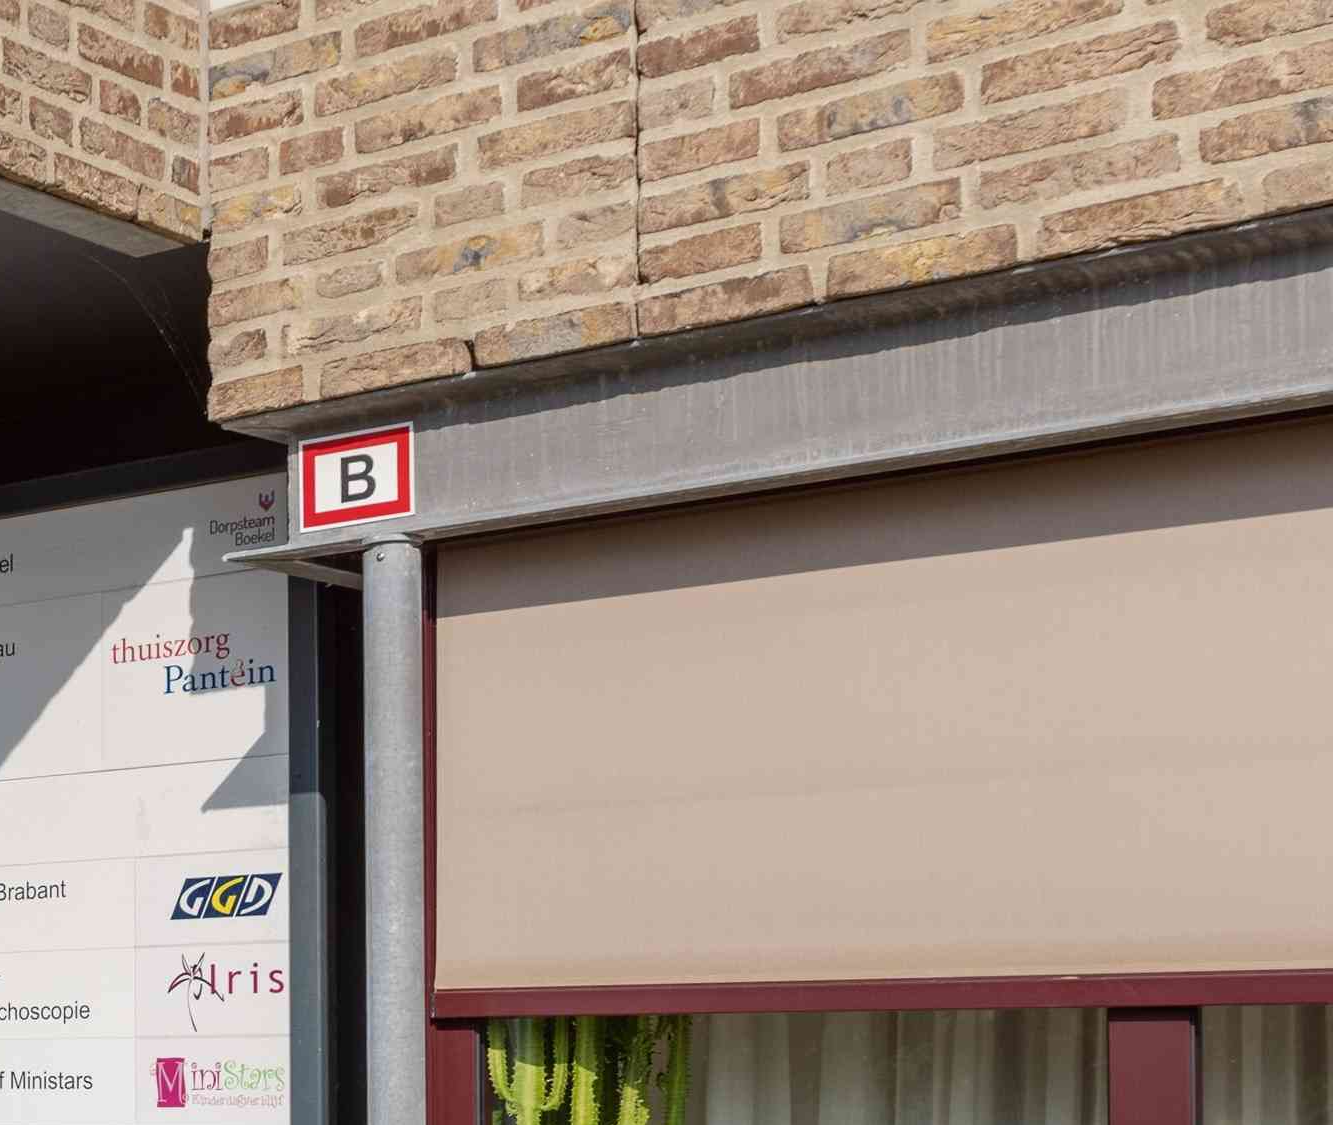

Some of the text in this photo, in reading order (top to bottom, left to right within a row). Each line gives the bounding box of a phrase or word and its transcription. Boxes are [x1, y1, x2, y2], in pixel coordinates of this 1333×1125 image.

[341, 454, 377, 503] B
[210, 514, 276, 536] Dorpsteam
[235, 527, 276, 546] Boekel
[111, 632, 230, 665] thuiszorg
[173, 874, 280, 918] GGD
[209, 961, 286, 995] Iris
[9, 1069, 94, 1092] Ministars
